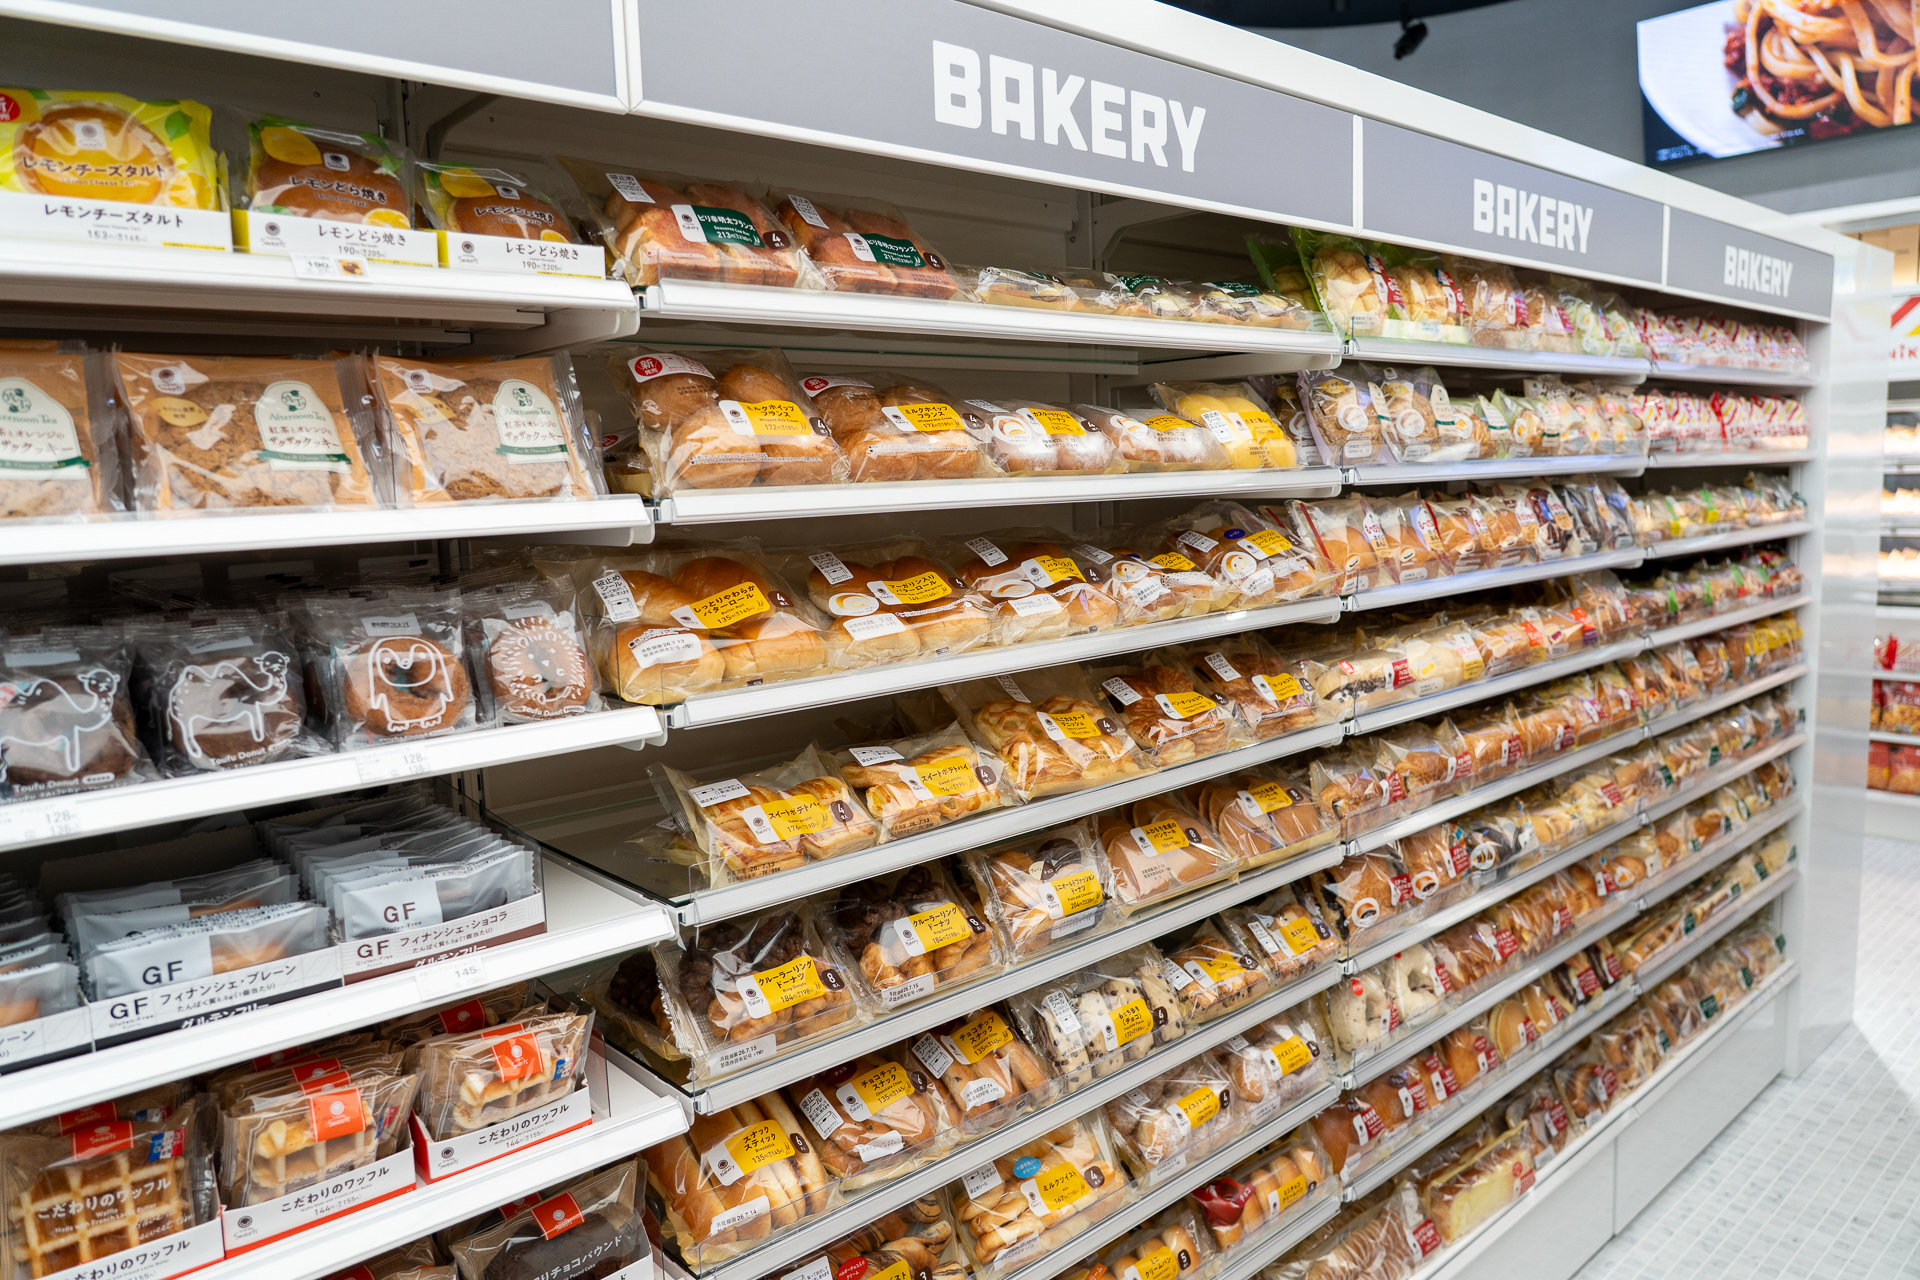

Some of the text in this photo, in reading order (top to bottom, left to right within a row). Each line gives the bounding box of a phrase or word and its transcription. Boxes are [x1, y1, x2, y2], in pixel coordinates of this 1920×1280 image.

[933, 40, 1206, 172] BAKERY
[23, 156, 165, 179] レモンチーズタルト
[290, 176, 387, 203] レモンどら焼き
[44, 204, 183, 228] レモンチーズタルト
[473, 206, 554, 225] レモンどら焼き
[1473, 178, 1593, 253] BAKERY
[316, 224, 406, 246] レモンどら焼き
[772, 233, 781, 243] 4
[504, 241, 580, 260] レモンどら焼き
[930, 255, 938, 263] 4
[1724, 244, 1793, 297] BAKERY
[640, 358, 655, 369] 新
[270, 411, 326, 422] Afternoon Tea
[505, 407, 550, 416] Afternoon Tea
[747, 405, 794, 413] ミルクホイップ
[269, 426, 333, 436] 紅茶とオレンジの
[504, 421, 557, 429] 紅茶とオレンジの
[268, 436, 341, 449] ザクザククッキー
[504, 431, 564, 443] ザクザククッキー
[596, 574, 621, 586] 袋止め
[600, 581, 622, 592] シール
[889, 574, 935, 589] マーガリン入り
[896, 581, 938, 593] バターロール
[693, 584, 756, 613] しっとりやわらか
[703, 593, 754, 617] バターロール
[776, 592, 785, 602] 4
[1103, 719, 1109, 728] 4
[210, 747, 267, 765] Toufu Donut
[921, 764, 969, 783] スイートポテトパイ
[980, 769, 988, 778] 4
[14, 783, 46, 794] Toufu
[48, 777, 80, 789] Donut
[1290, 788, 1298, 796] 8
[769, 801, 823, 819] スイートポテトパイ
[838, 803, 845, 814] 4
[1153, 829, 1177, 839] パンケーキ
[1190, 829, 1197, 838] 8
[383, 901, 416, 923] GF
[912, 906, 957, 927] クルーラーリング
[400, 911, 509, 947] フィナンシェ・ショコラ
[928, 919, 951, 931] ドーナツ
[969, 918, 979, 926] 8
[1319, 925, 1326, 934] 6
[357, 939, 390, 959] GF
[1246, 956, 1252, 965] 6
[142, 960, 184, 986] GF
[758, 960, 812, 986] クルーラーリング
[776, 973, 805, 989] ドーナツ
[827, 972, 836, 984] 8
[160, 964, 297, 1006] フィナンシェ・プレーン
[110, 997, 148, 1021] GF
[959, 1015, 995, 1042] チョコチップ
[969, 1024, 994, 1044] スナック
[861, 1065, 898, 1089] チョコチップ
[872, 1074, 897, 1092] スナック
[1183, 1091, 1216, 1115] ツイストドーナツ
[478, 1104, 570, 1144] こだわりのワッフル
[743, 1126, 770, 1144] スナック
[744, 1132, 777, 1151] スティック
[1043, 1170, 1077, 1192] ミルクツイスト
[1090, 1168, 1098, 1179] 4
[38, 1176, 172, 1219] こだわりのワッフル
[281, 1166, 390, 1213] こだわりのワッフル
[1239, 1187, 1252, 1203] チョコ
[96, 1208, 119, 1218] Waffle
[55, 1224, 72, 1233] Made
[91, 1216, 114, 1227] French
[1149, 1257, 1160, 1266] ミニ
[1180, 1252, 1188, 1262] 5
[585, 1264, 596, 1273] Cake
[1145, 1257, 1172, 1279] クリームパン
